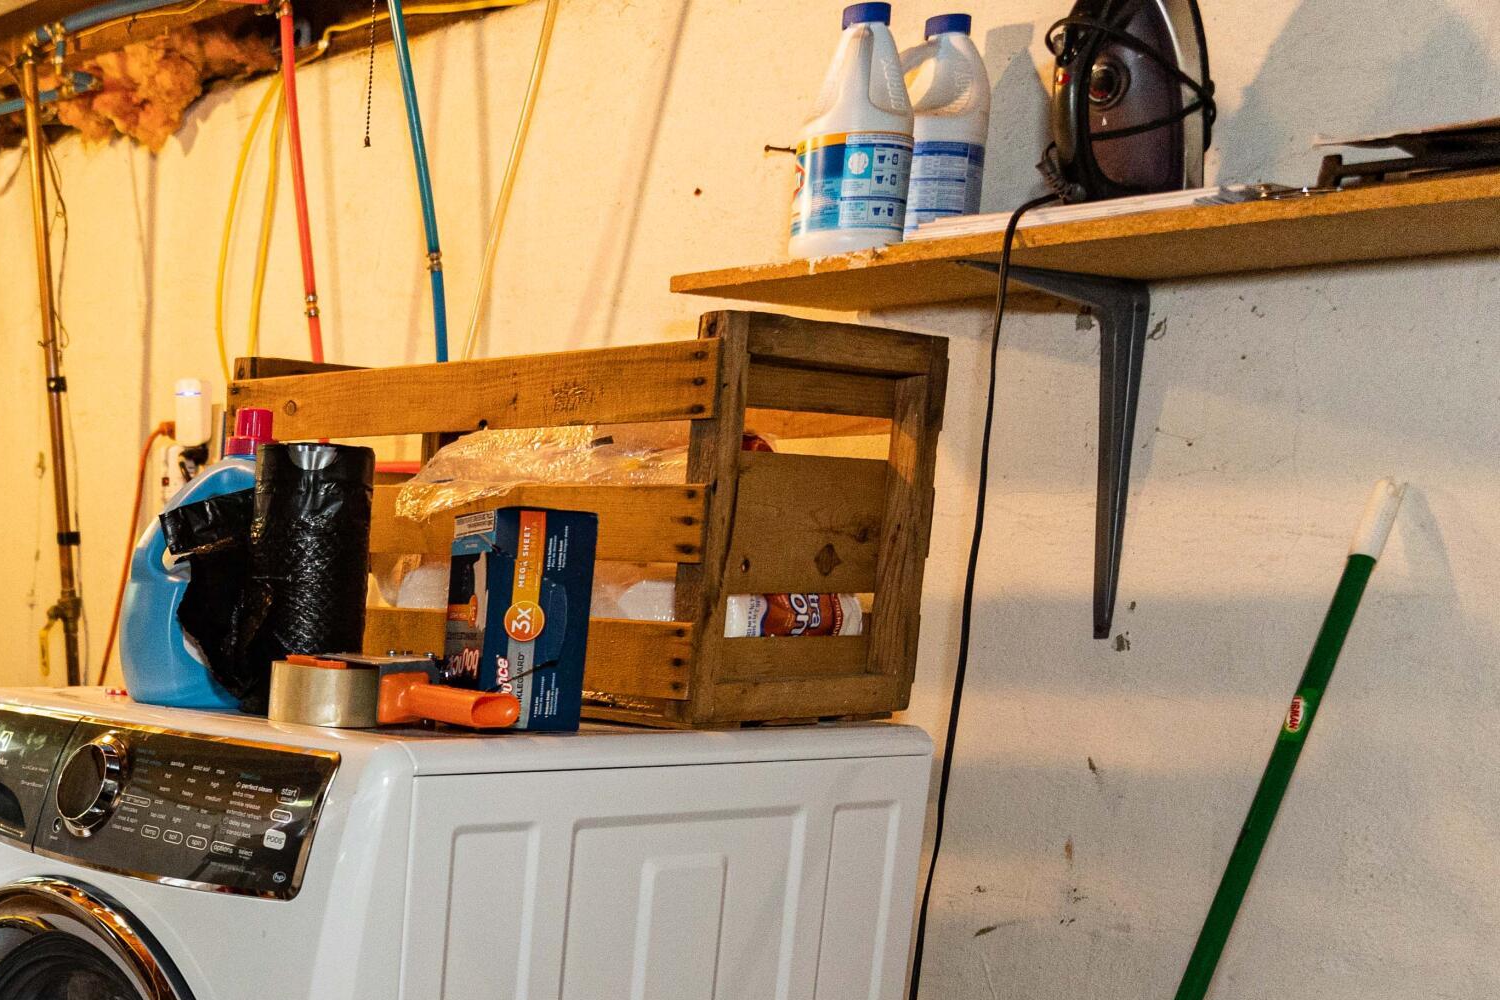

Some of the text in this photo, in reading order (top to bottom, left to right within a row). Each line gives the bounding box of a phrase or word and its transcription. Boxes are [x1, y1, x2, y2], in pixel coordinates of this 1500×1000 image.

[522, 526, 531, 558] SHEET
[241, 783, 258, 791] perfect
[281, 788, 297, 797] start
[213, 844, 233, 854] options
